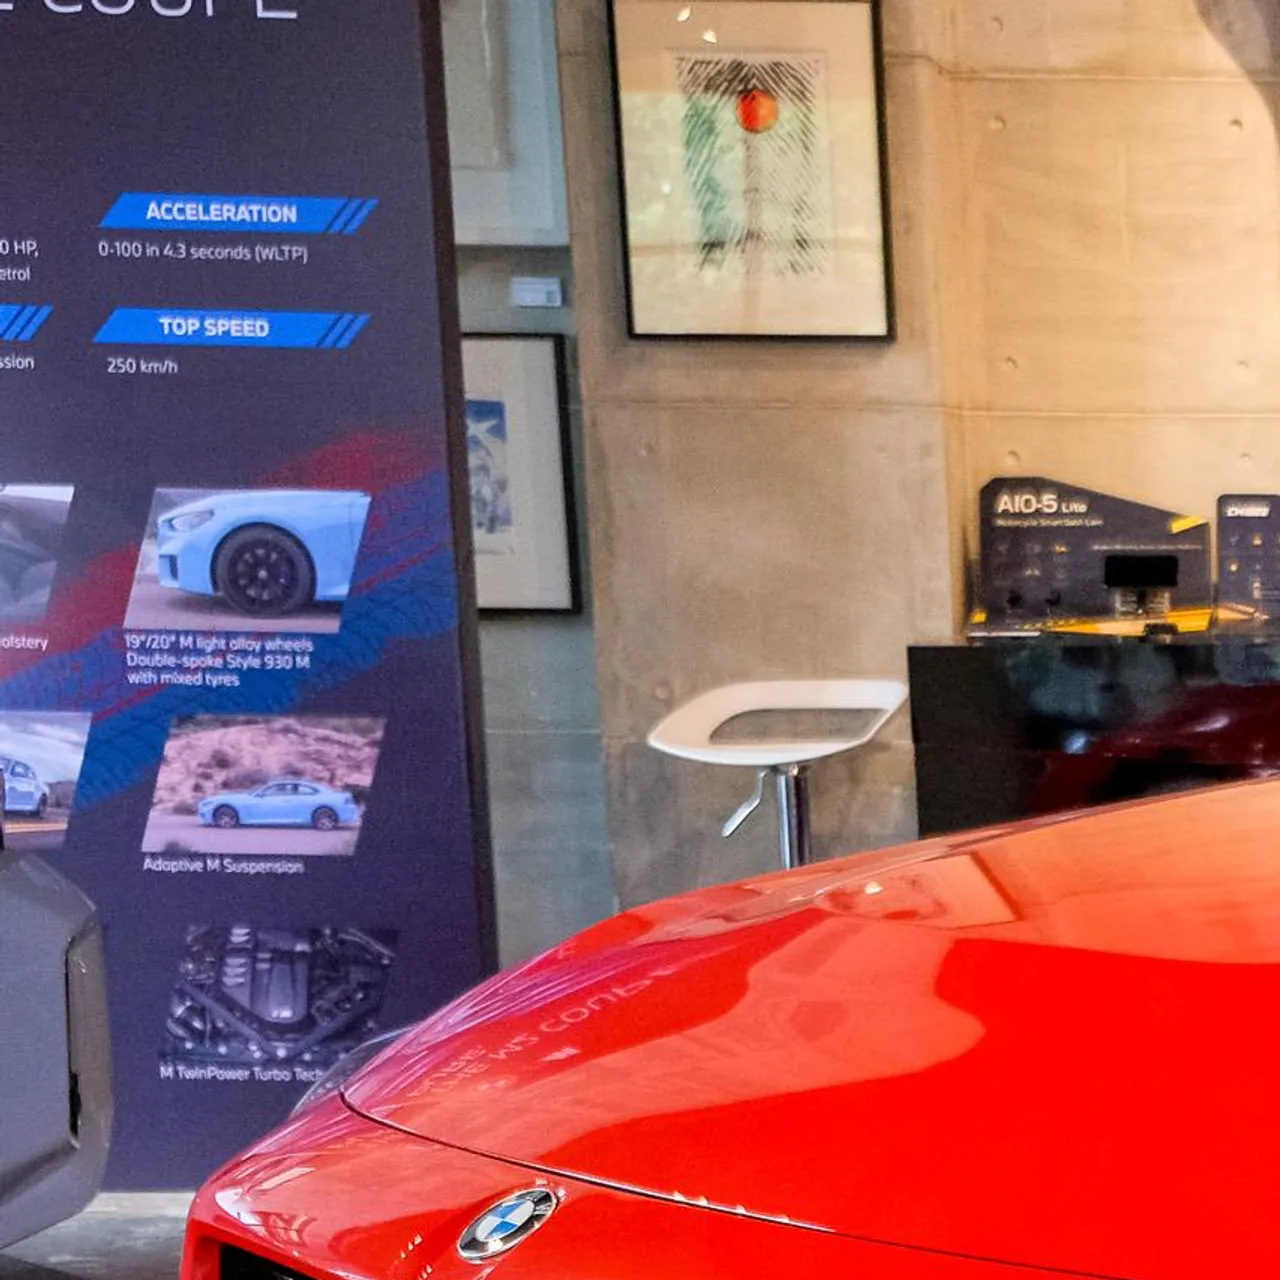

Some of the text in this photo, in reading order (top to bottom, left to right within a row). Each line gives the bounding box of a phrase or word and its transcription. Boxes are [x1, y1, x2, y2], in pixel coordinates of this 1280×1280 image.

[146, 200, 298, 223] ACCELERATION
[0, 239, 39, 258] 0 HP,
[98, 240, 309, 264] 0-100 in 4.3 seconds (WLTP)
[0, 266, 30, 281] etrol
[159, 316, 270, 338] TOP SPEED
[0, 353, 35, 370] sion
[107, 357, 179, 375] 250 km/h
[998, 493, 1088, 513] AIO-5 Lite
[0, 633, 49, 652] olstery
[179, 635, 194, 650] M
[196, 635, 226, 652] light
[228, 636, 261, 653] alloy
[263, 637, 314, 653] wheels
[126, 652, 311, 671] Double-spoke Style 930 M
[128, 671, 240, 688] with mixed tyres
[143, 857, 305, 875] Adaptive M Suspension
[159, 1064, 325, 1082] M TwinPower Turbo Tech
